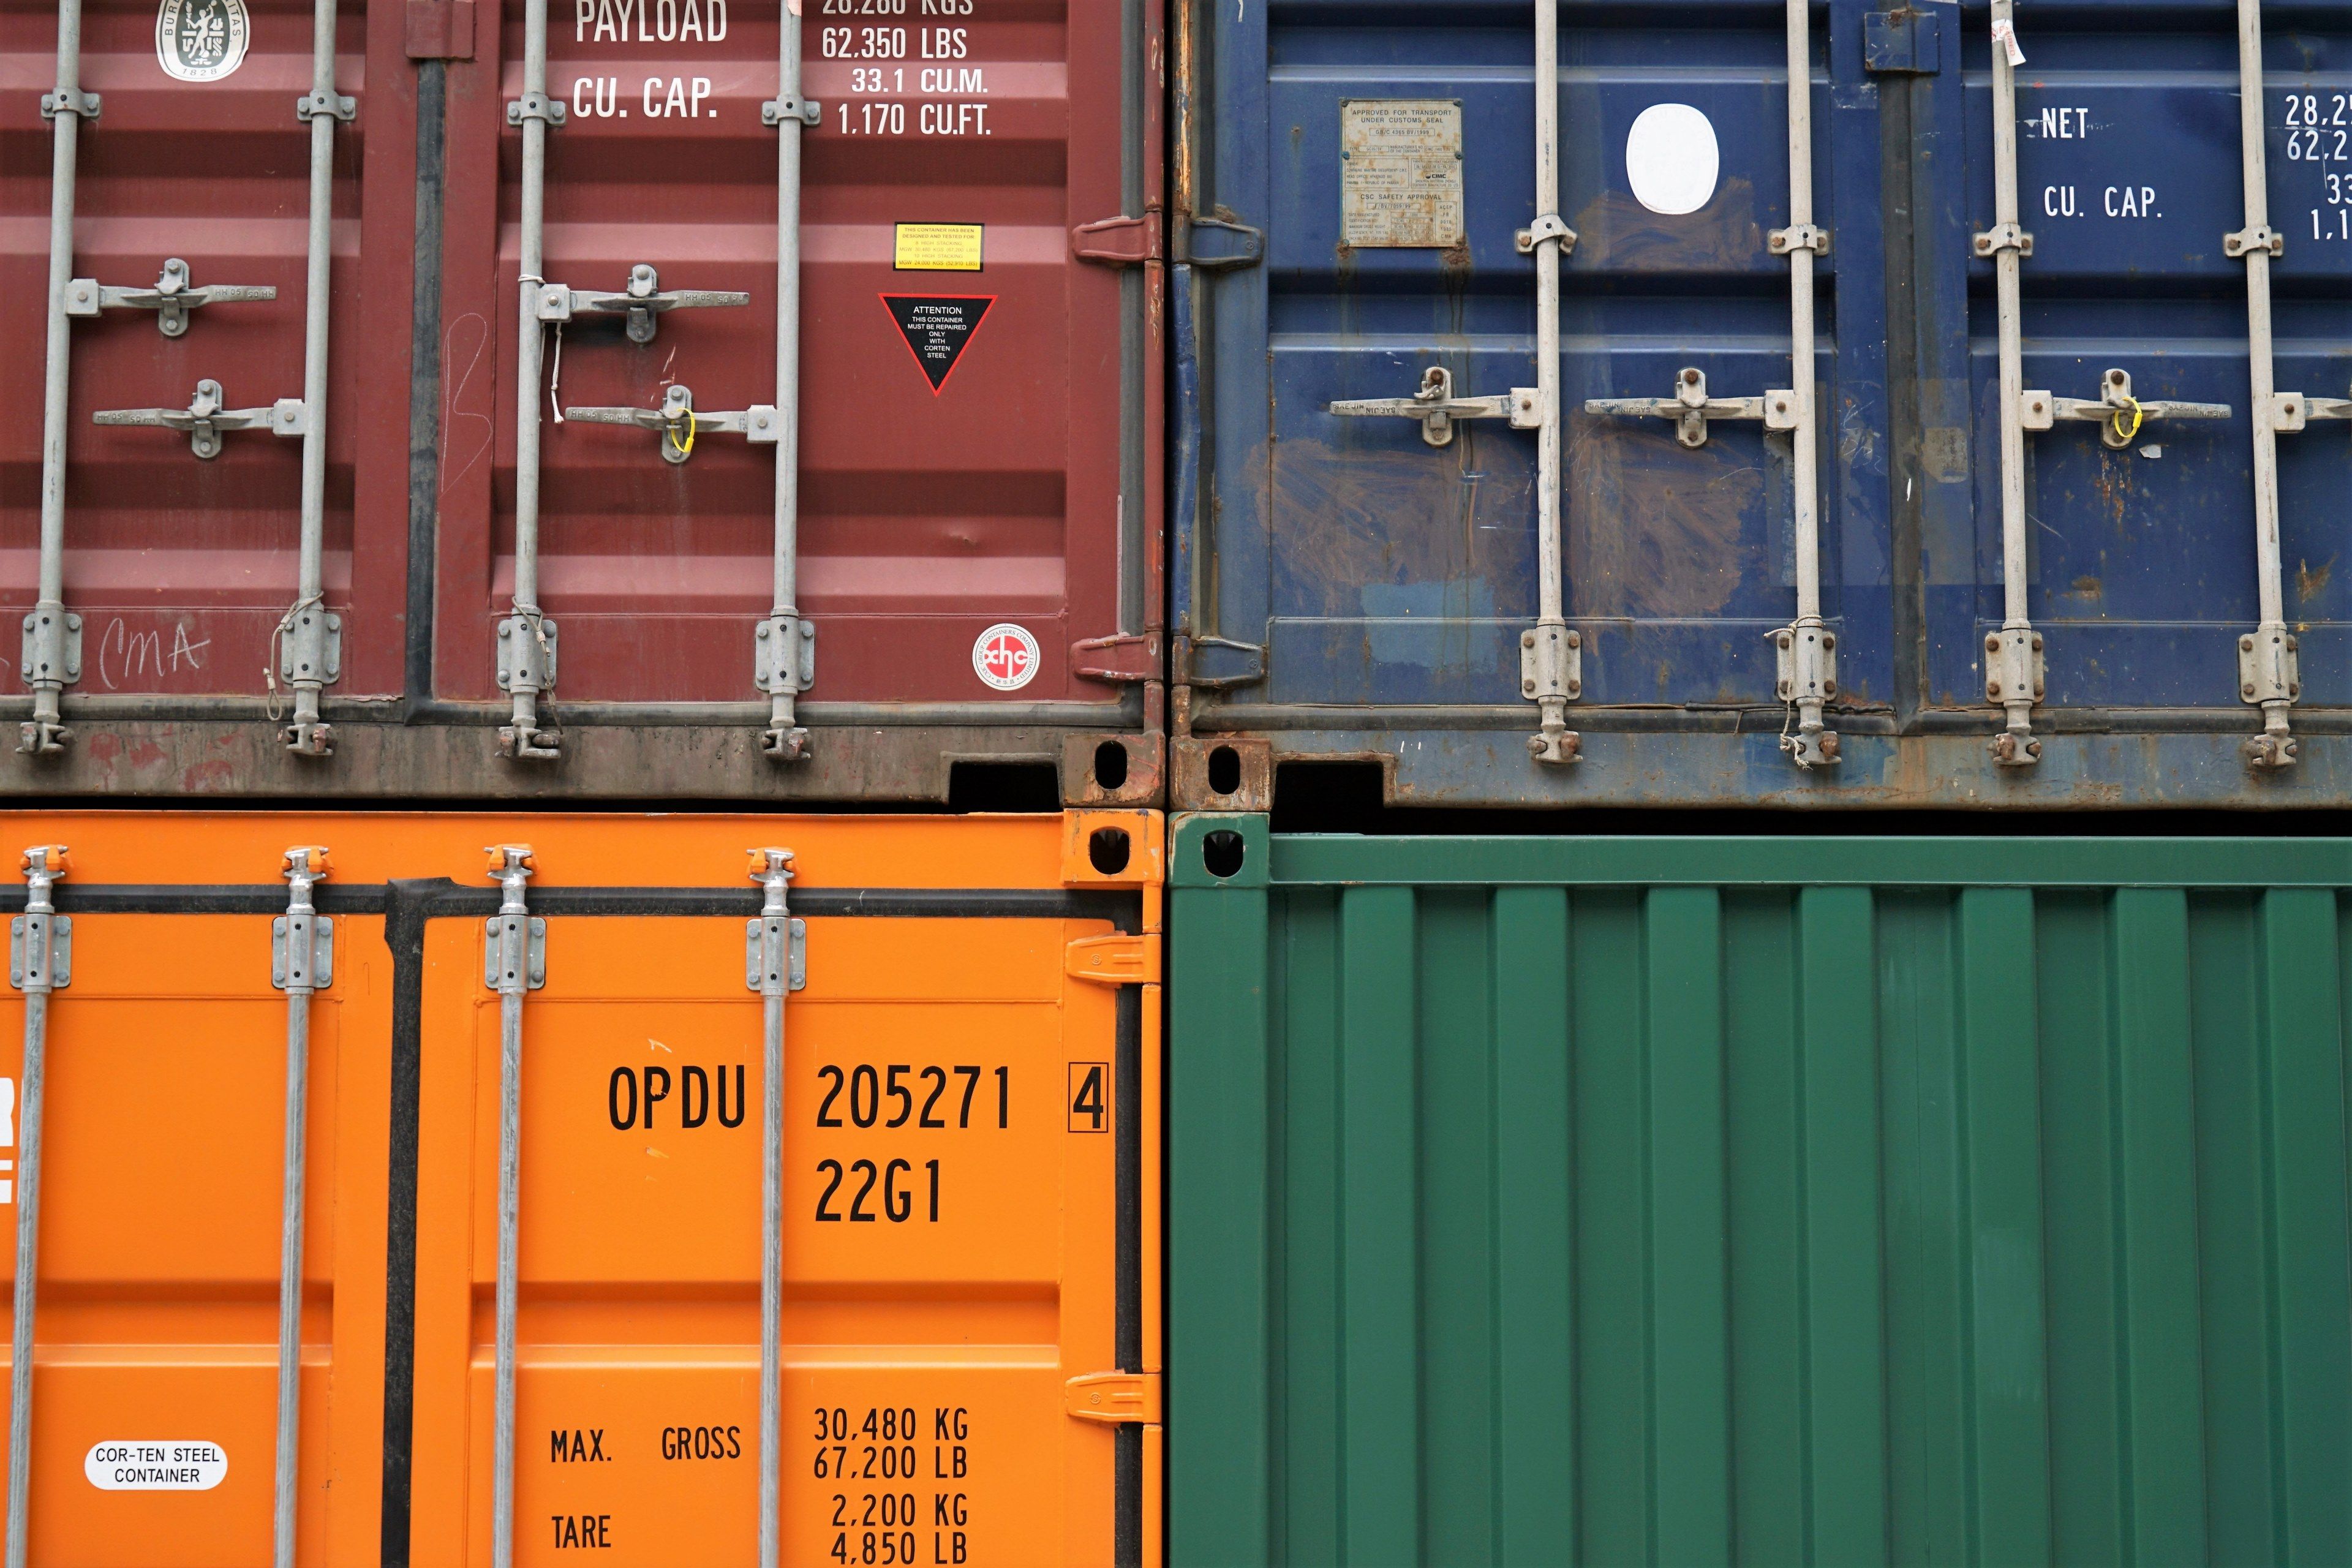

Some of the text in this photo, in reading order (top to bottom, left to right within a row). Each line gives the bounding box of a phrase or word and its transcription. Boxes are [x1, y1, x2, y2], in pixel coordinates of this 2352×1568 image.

[576, 0, 726, 42] PAYLOAD
[823, 27, 967, 59] 62,350 LBS
[183, 68, 217, 77] 1828
[851, 68, 988, 93] 33.1 CU.M.
[573, 77, 717, 118] CU. CAP.
[839, 103, 991, 135] 1,170 CU.FT.
[2040, 108, 2089, 138] NET
[2045, 186, 2162, 217] CU. CAP.
[99, 617, 211, 690] CMA
[982, 629, 1016, 645] CONTAINERS
[1016, 632, 1034, 655] COMPANY
[1020, 657, 1035, 679] LIMITED
[609, 1065, 1104, 1131] OPDU 205271 4
[815, 1159, 939, 1223] 22G1
[815, 1408, 968, 1442] 30,480 KG
[96, 1448, 220, 1462] COR-TEN STEEL
[551, 1426, 741, 1463] MAX. GROSS
[115, 1468, 200, 1483] CONTAINER
[814, 1446, 967, 1480] 67,200 LB
[832, 1493, 968, 1528] 2,200 KG
[552, 1515, 611, 1549] TARE
[831, 1532, 967, 1566] 4,850 LB
